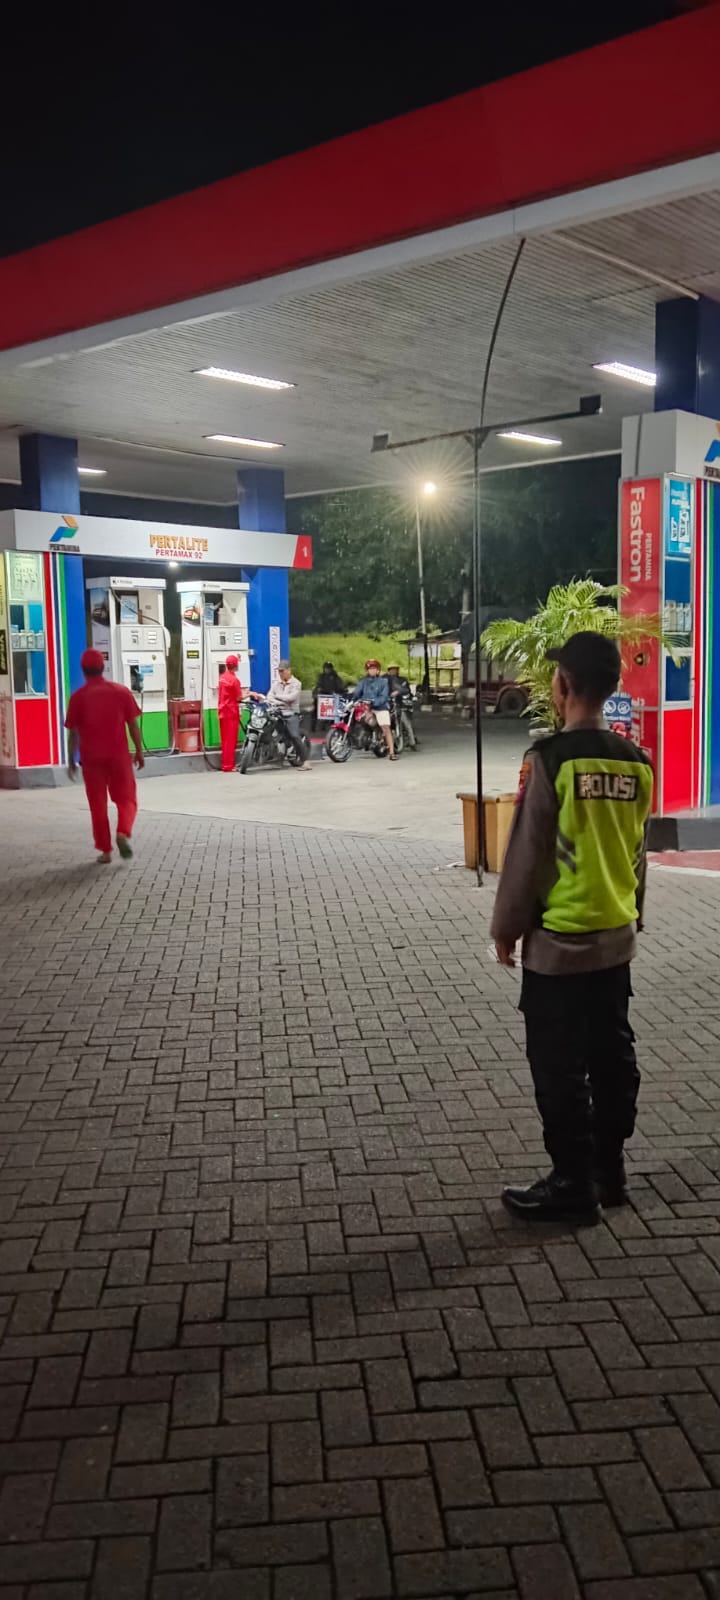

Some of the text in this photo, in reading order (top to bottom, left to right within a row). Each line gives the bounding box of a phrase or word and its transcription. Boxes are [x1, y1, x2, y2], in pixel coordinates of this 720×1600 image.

[149, 534, 209, 551] PERTALITE
[630, 486, 645, 582] Fastron
[155, 549, 203, 559] PERTAMAX 92
